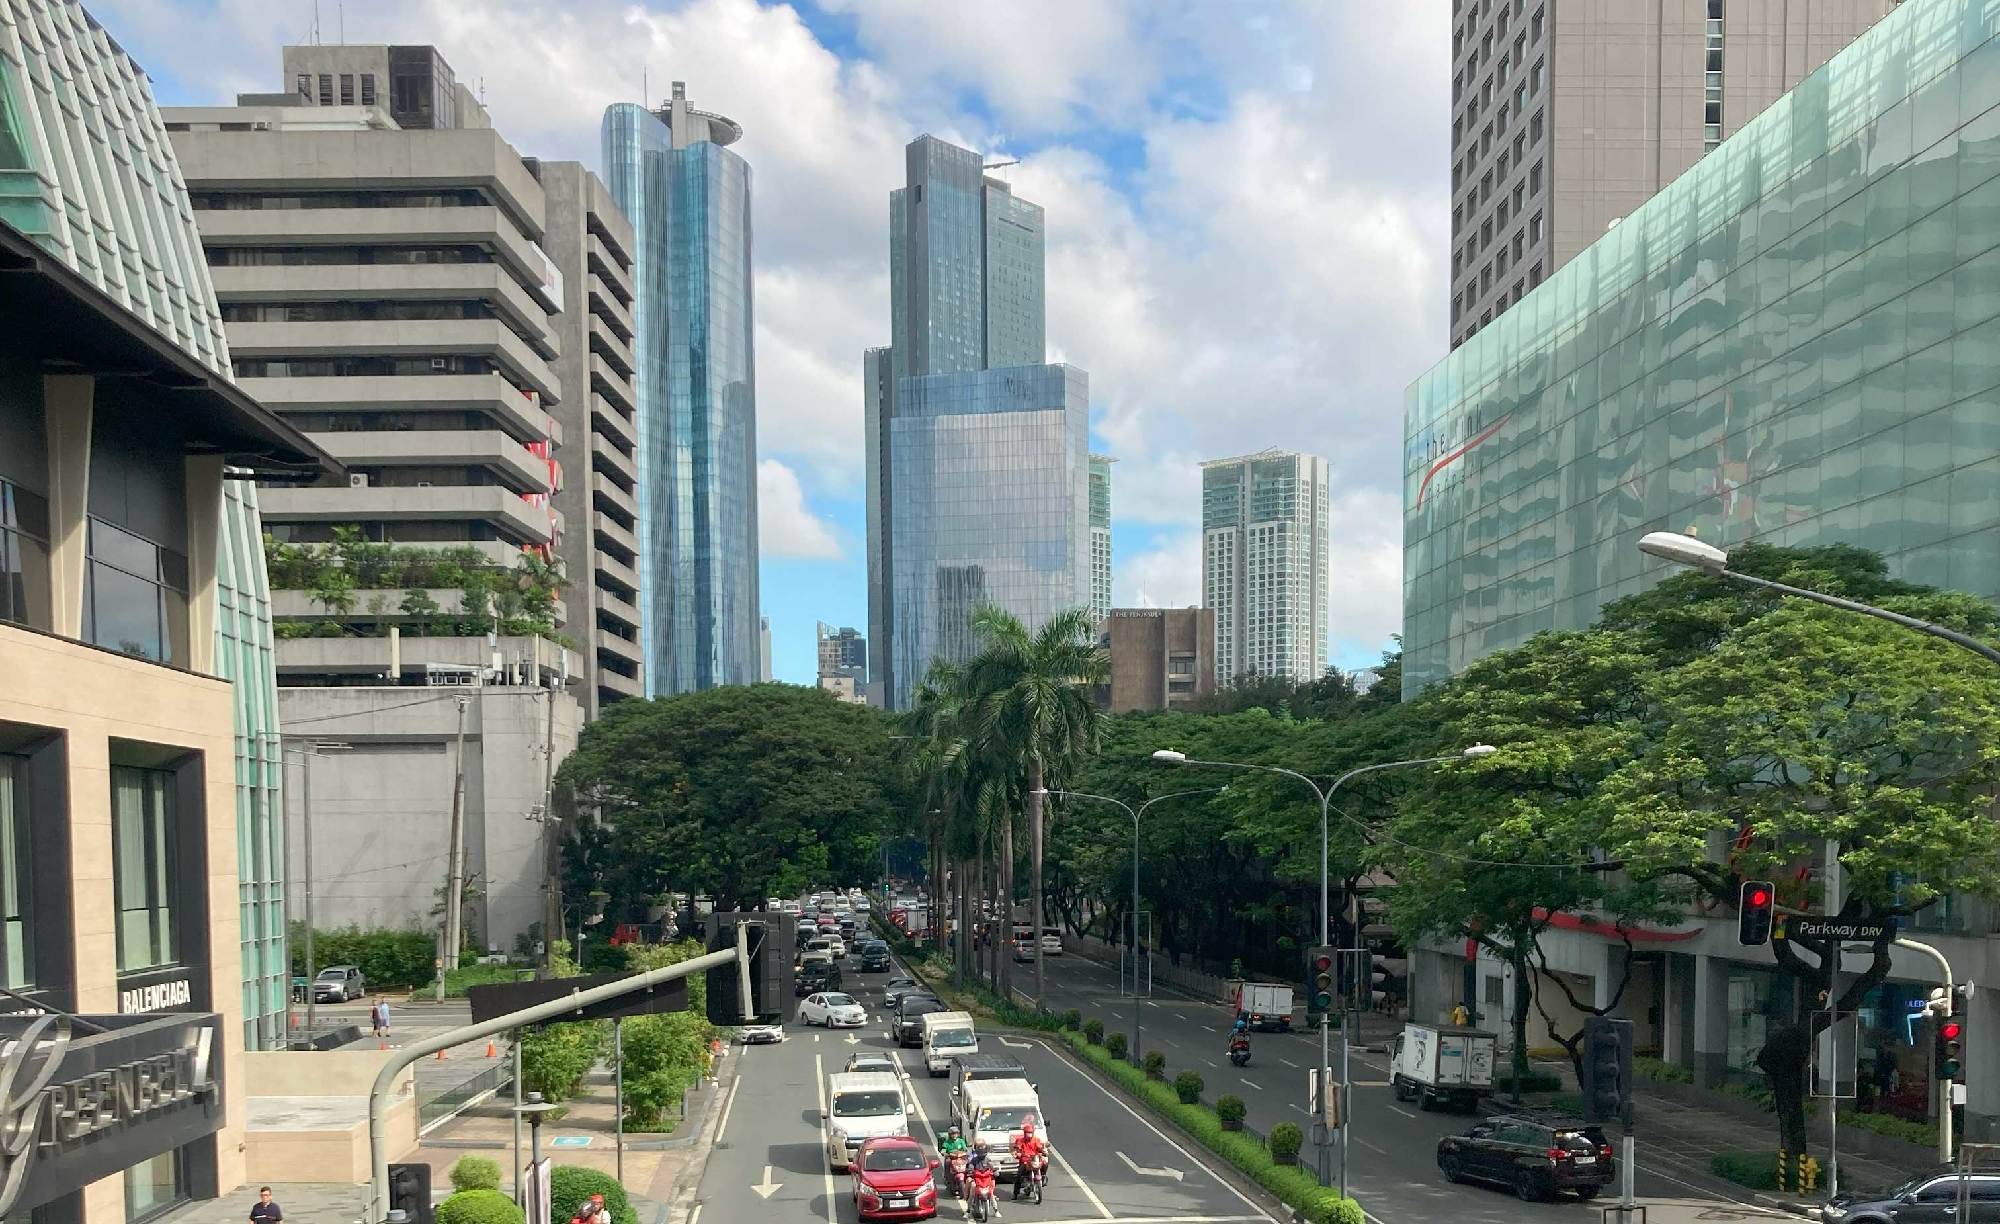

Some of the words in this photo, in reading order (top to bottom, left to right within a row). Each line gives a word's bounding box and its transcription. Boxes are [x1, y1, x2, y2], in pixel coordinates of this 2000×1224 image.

[1800, 921, 1857, 938] Parkway
[1861, 926, 1883, 936] DRV
[123, 980, 190, 1014] BALENCIAGA
